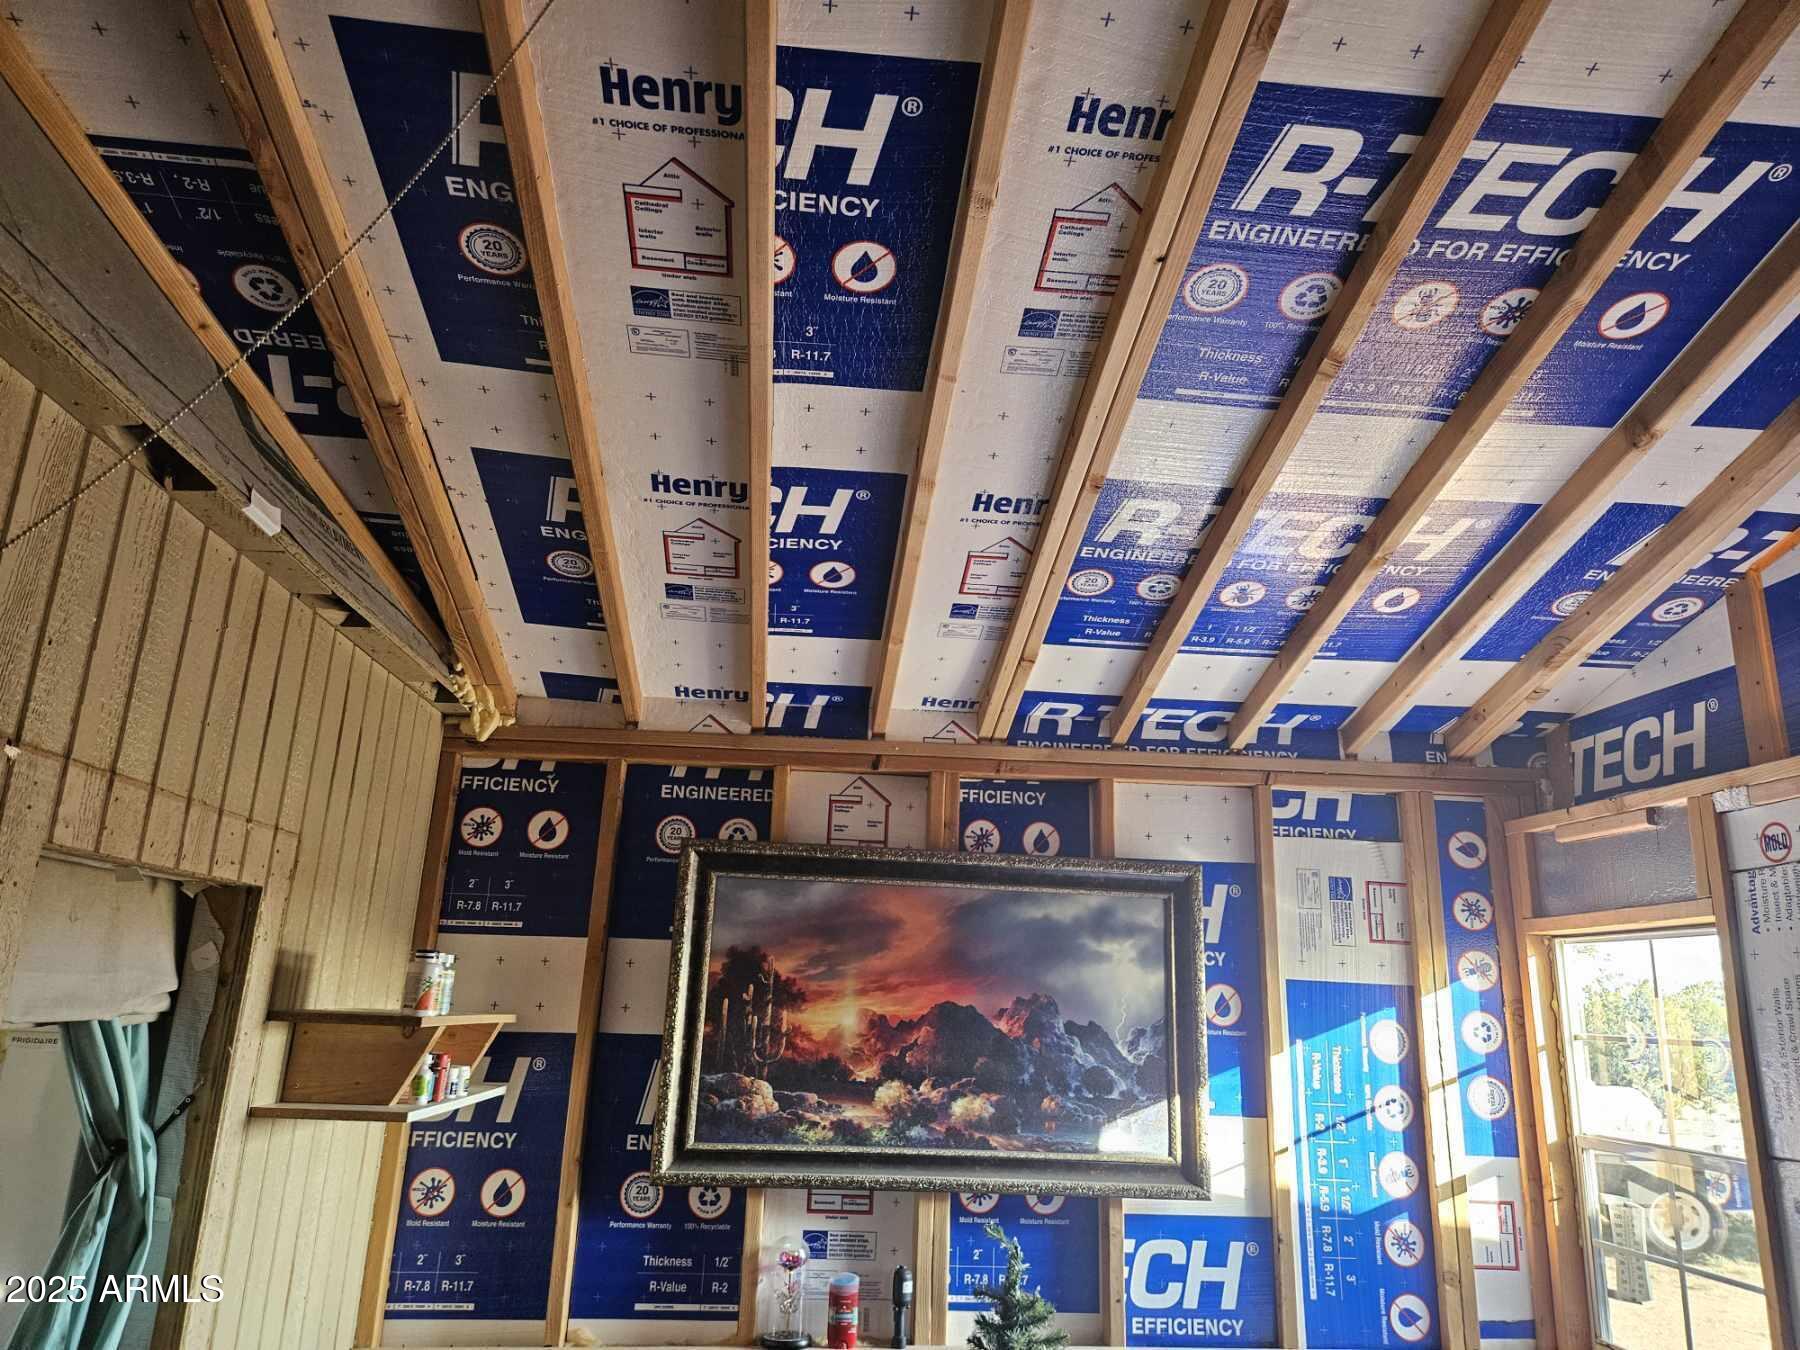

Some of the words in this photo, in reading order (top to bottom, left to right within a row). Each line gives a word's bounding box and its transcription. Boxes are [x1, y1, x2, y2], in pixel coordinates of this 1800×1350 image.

[600, 66, 742, 126] Henry
[1067, 96, 1177, 141] Henr
[609, 119, 650, 132] CHOICE
[653, 123, 668, 132] OF
[1064, 146, 1103, 158] CHOICE
[1105, 151, 1120, 159] OF
[482, 238, 503, 252] 20
[1429, 239, 1488, 261] FOR
[1210, 279, 1228, 290] 20
[791, 349, 832, 362] R-11.7
[1198, 346, 1263, 364] Thickness
[1199, 370, 1250, 386] R-Value
[651, 473, 748, 503] Henry
[1083, 615, 1131, 625] Thickness
[1085, 628, 1121, 637] R-Value
[674, 685, 749, 702] Henry
[670, 827, 682, 836] 20
[456, 900, 482, 911] R-7.8
[491, 901, 522, 912] R-11.7
[1761, 878, 1771, 923] Moisture
[11, 1035, 59, 1045] FRIGIDAIRE
[635, 1186, 649, 1195] 20
[1321, 1224, 1333, 1253] R-7.8
[643, 1255, 693, 1267] Thickness
[404, 1280, 431, 1292] R-7.8
[441, 1280, 474, 1292] R-11.7
[964, 1274, 989, 1285] R-7.8
[1324, 1263, 1336, 1297] R-11.7
[650, 1281, 687, 1293] R-Value
[711, 1282, 729, 1293] R-2
[1132, 1317, 1244, 1336] EFFICIENCY
